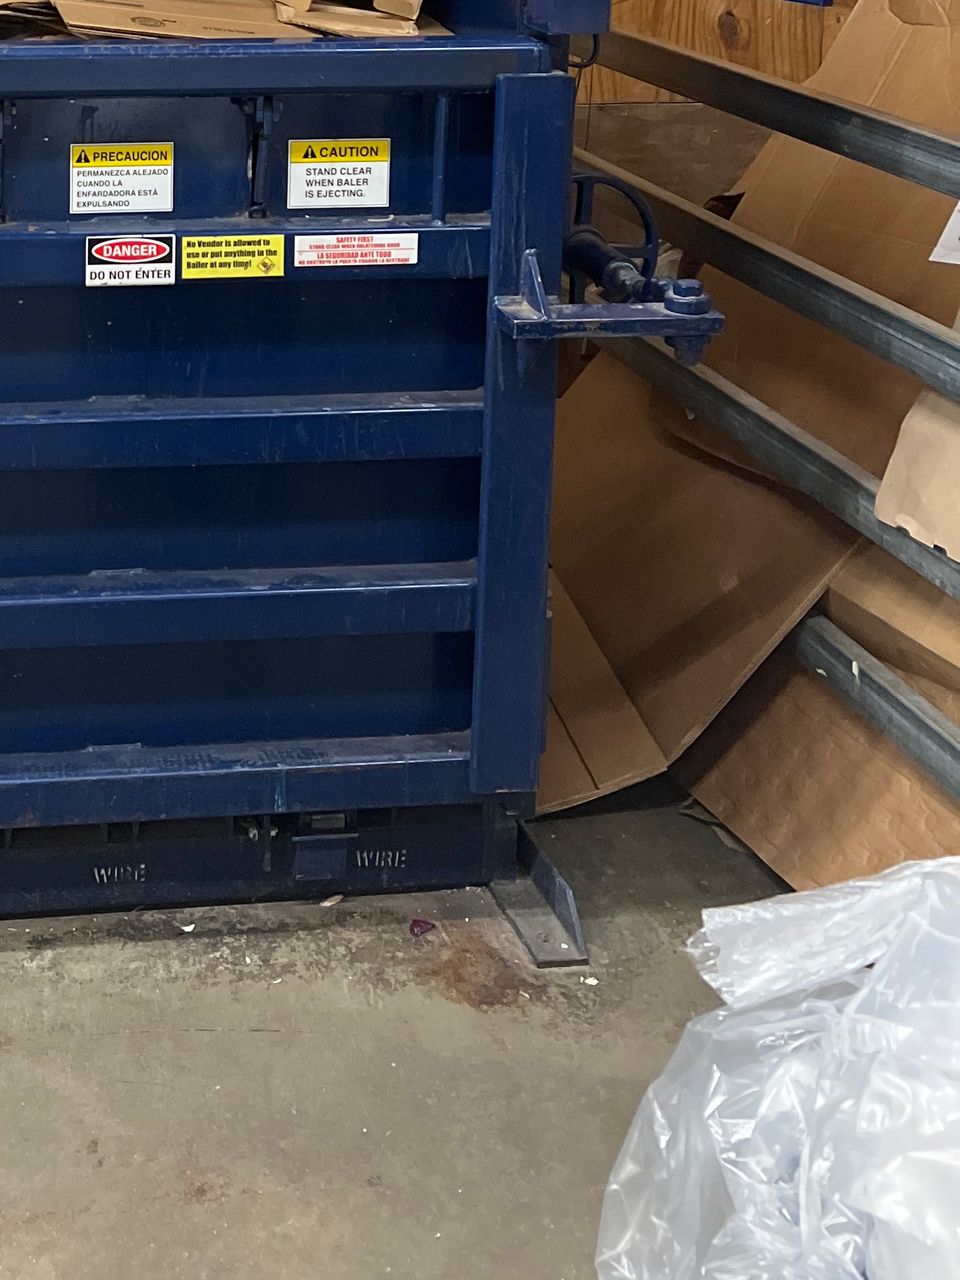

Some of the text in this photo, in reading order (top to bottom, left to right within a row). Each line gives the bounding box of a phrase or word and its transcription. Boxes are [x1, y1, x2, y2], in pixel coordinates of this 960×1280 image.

[93, 151, 167, 161] PRECAUCION
[320, 147, 379, 157] CAUTION
[306, 167, 372, 176] STAND CLEAR
[306, 178, 369, 187] WHEN BALER
[305, 190, 314, 198] IS
[103, 245, 157, 257] DANGER
[224, 249, 255, 257] anything
[90, 270, 171, 280] DO NOT ENTER
[356, 849, 407, 869] WIRE
[94, 864, 146, 883] WIRE
